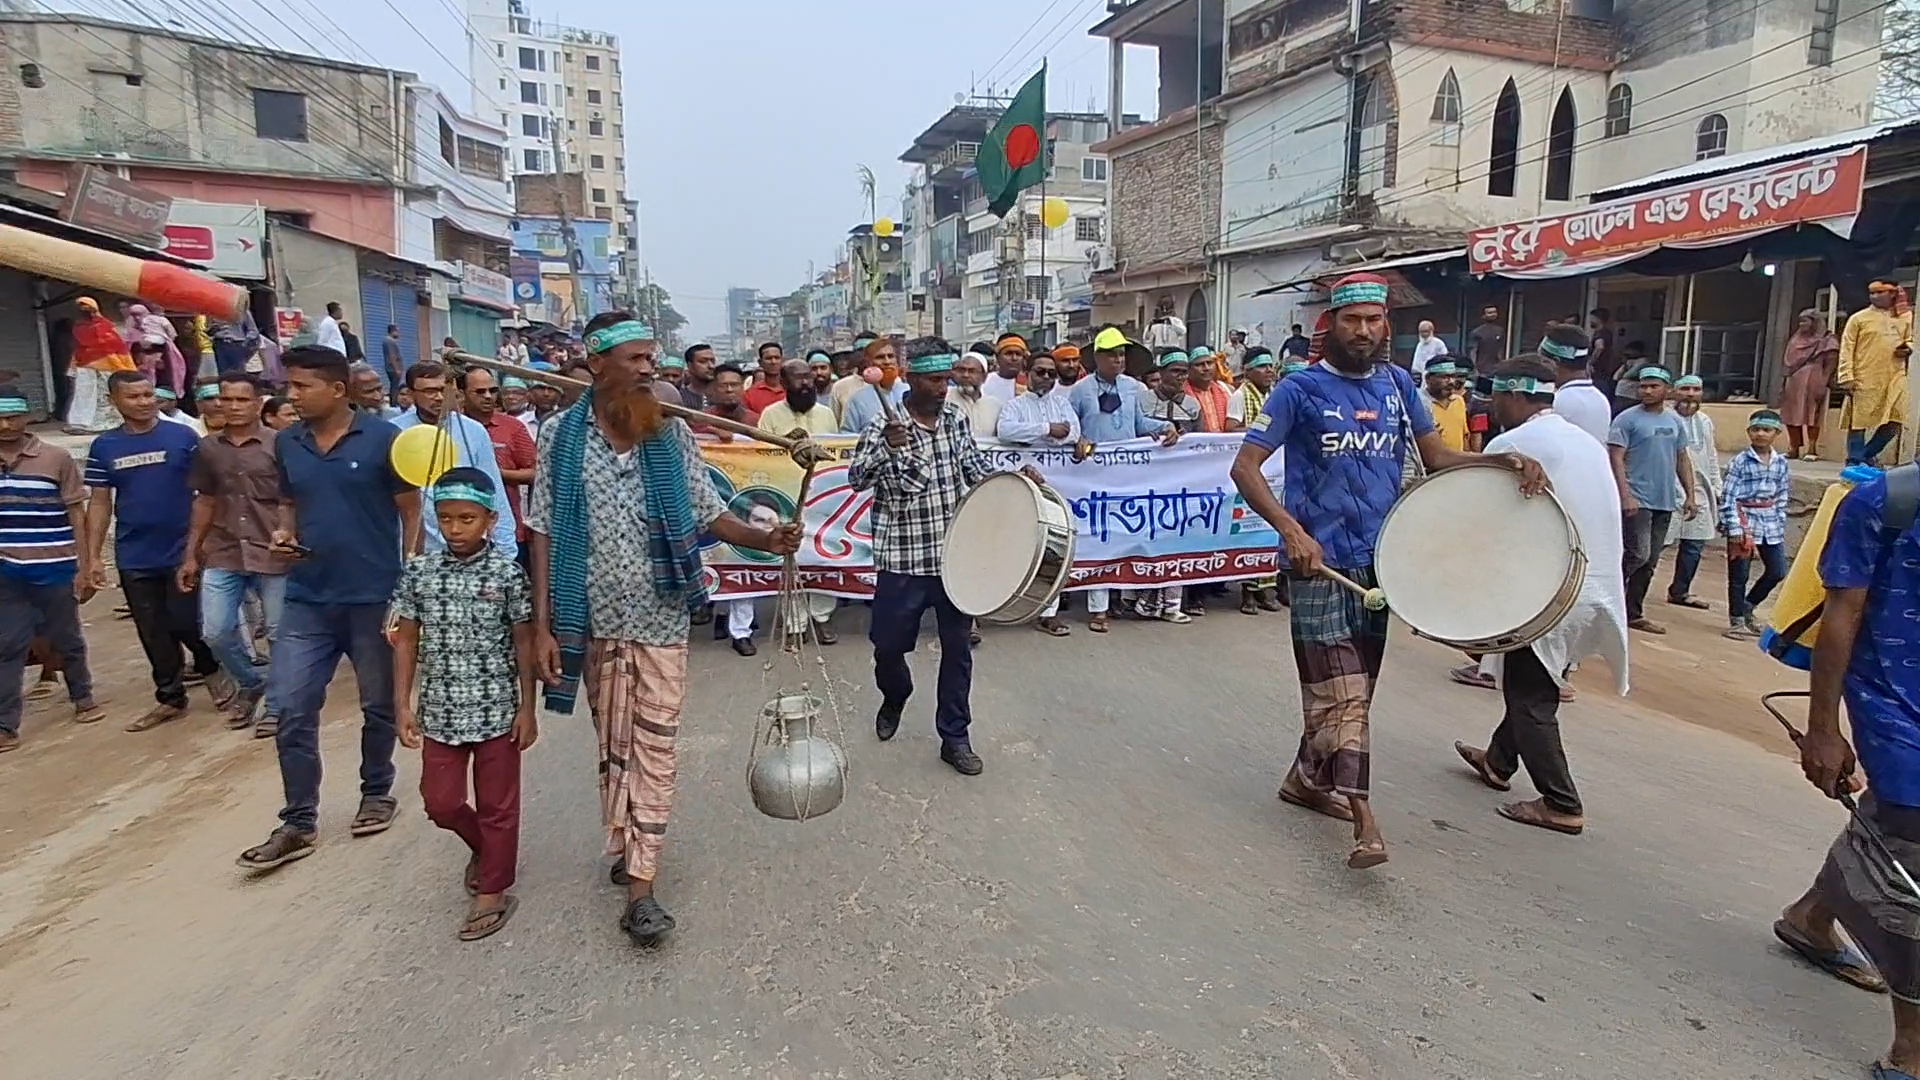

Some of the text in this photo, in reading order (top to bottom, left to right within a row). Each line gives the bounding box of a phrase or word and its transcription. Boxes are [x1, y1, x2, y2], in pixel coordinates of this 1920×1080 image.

[1564, 205, 1635, 246] হোটেল
[1644, 195, 1690, 227] এন্ড
[1321, 431, 1398, 451] SAVVY
[1130, 552, 1227, 578] জয়পুরহাট
